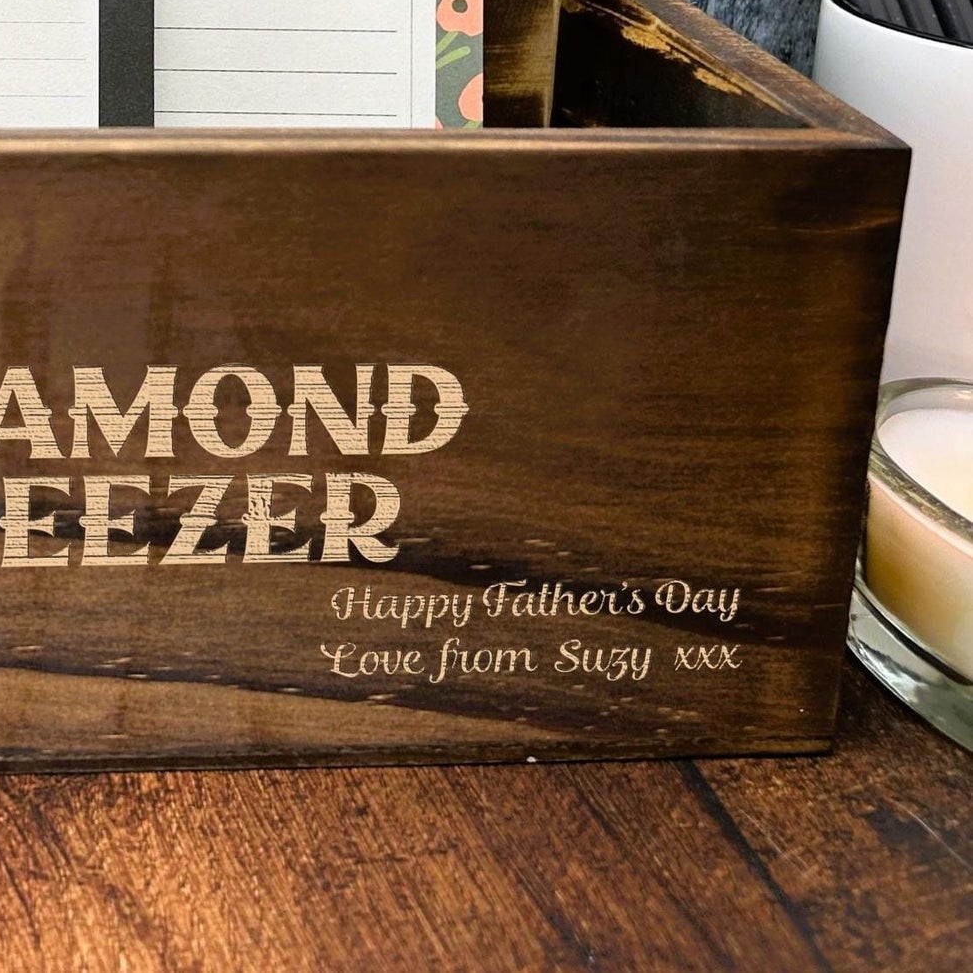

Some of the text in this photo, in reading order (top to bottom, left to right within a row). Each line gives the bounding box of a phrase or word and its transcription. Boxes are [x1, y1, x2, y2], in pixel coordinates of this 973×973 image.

[331, 578, 743, 628] Happy Father's Day
[320, 637, 743, 684] Love from Suzy xxx
